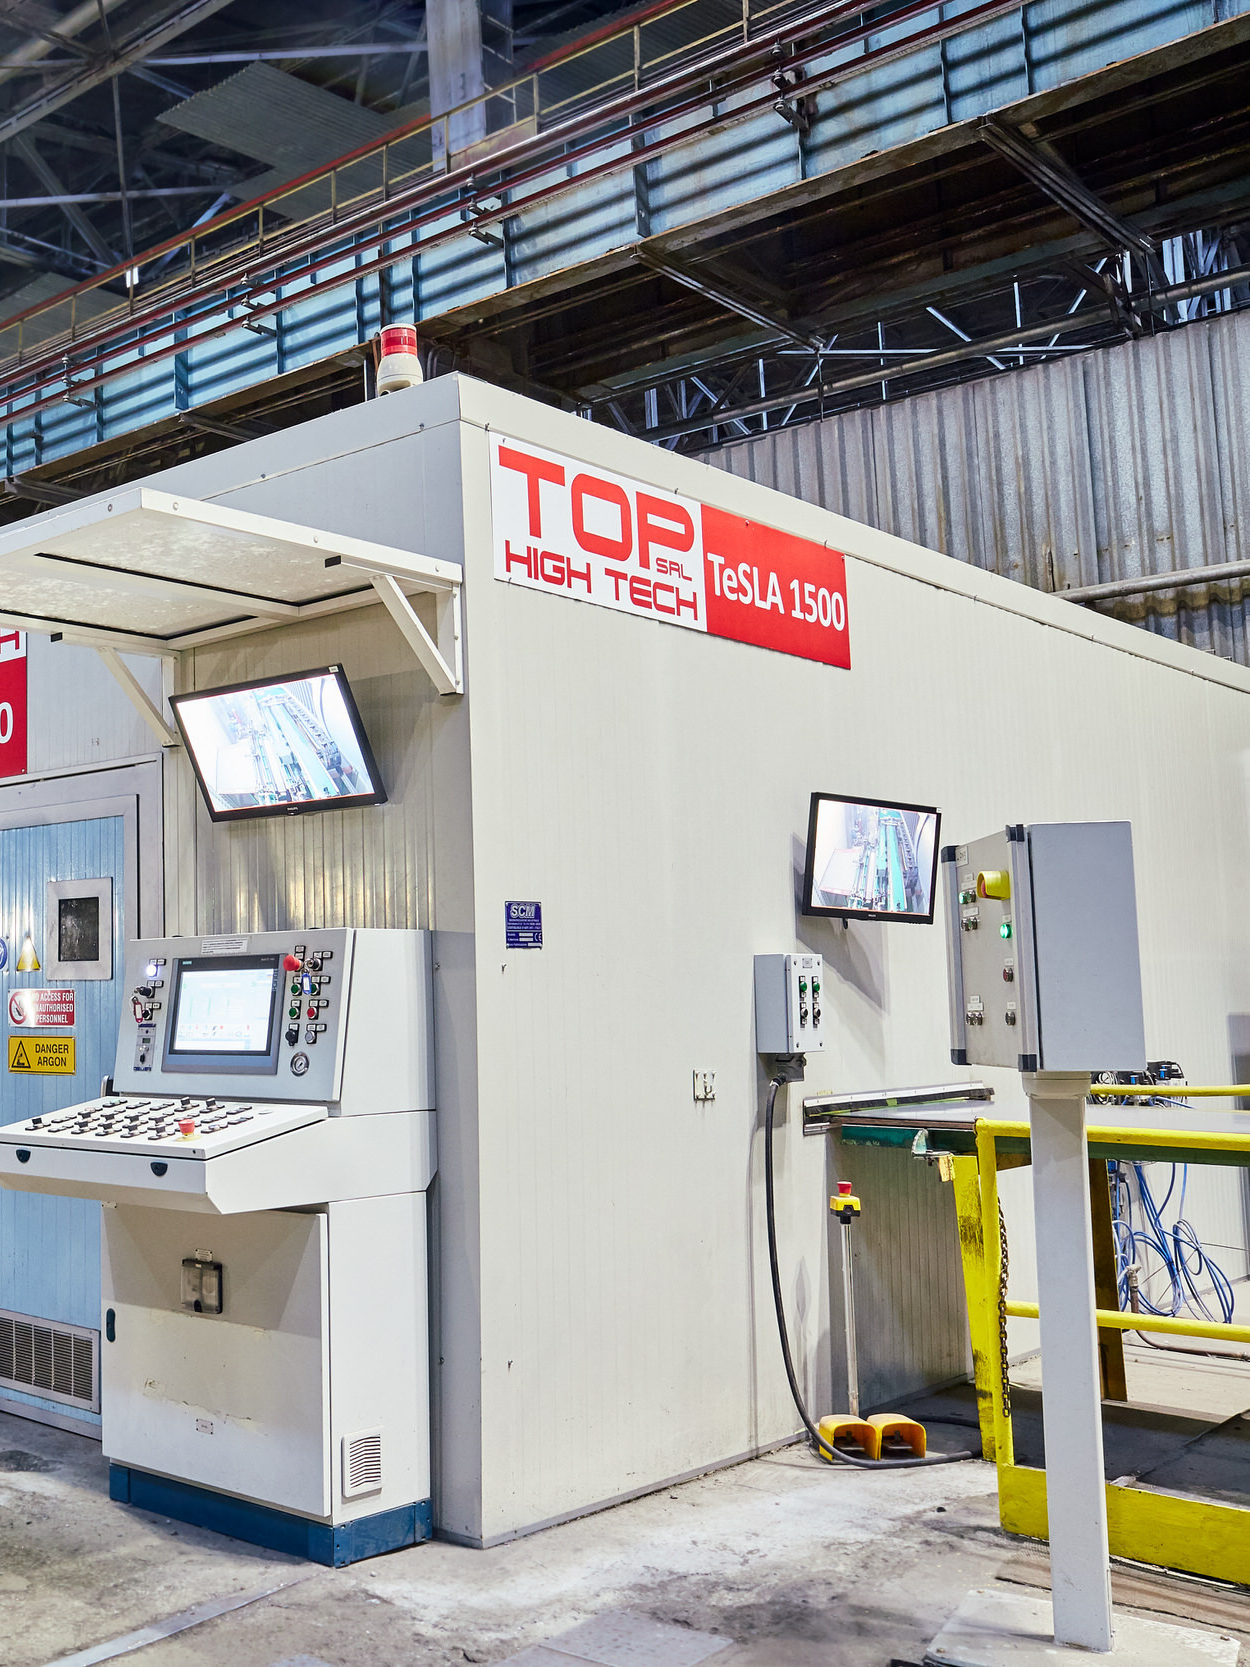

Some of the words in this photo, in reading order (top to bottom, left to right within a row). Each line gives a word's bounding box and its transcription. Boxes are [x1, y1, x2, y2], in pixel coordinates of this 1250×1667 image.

[498, 445, 695, 570] TOP
[656, 557, 693, 582] SRL
[505, 540, 592, 594] HIGH
[604, 568, 698, 621] TECH
[707, 552, 785, 616] TeSLA
[791, 578, 845, 632] 1500
[510, 904, 536, 918] SCM
[40, 992, 61, 1002] ACCESS
[62, 992, 74, 1001] FOR
[33, 1003, 74, 1012] AUTHORISED
[36, 1014, 68, 1023] PERSONNEL
[35, 1043, 69, 1054] DANGER
[37, 1057, 67, 1067] ARGON
